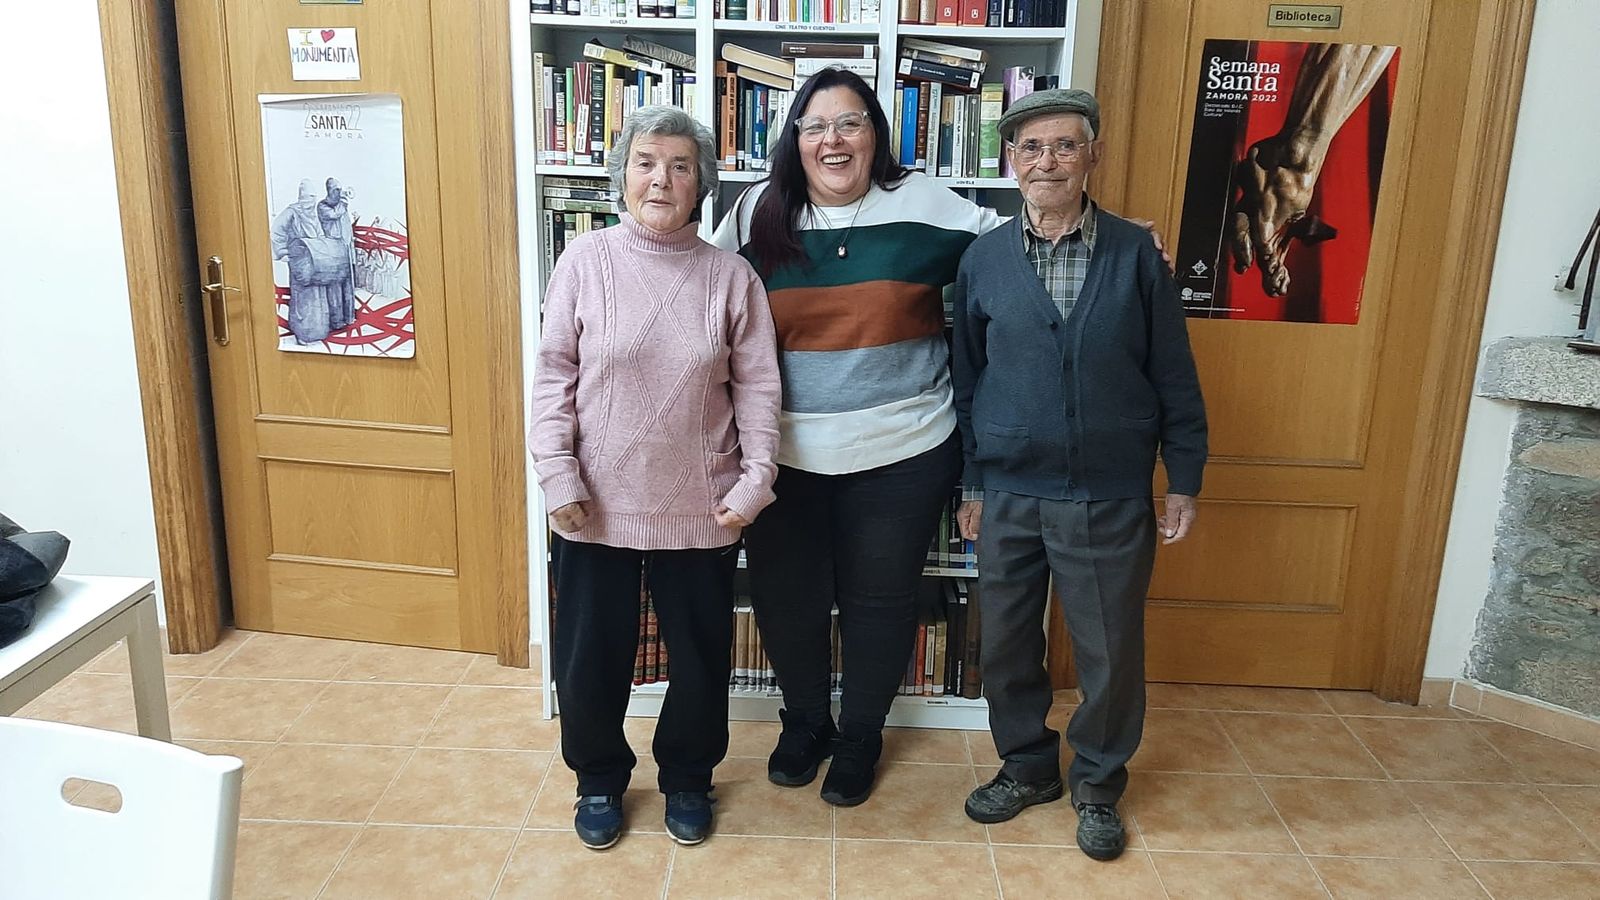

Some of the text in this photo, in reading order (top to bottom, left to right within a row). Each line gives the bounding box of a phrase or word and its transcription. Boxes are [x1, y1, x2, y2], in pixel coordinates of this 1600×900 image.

[1275, 10, 1332, 22] Biblioteca
[299, 30, 313, 46] I
[292, 47, 356, 63] MONUMENTA
[1209, 56, 1280, 74] Semana
[1206, 68, 1278, 92] Santa
[1205, 91, 1277, 102] ZAMORA 2022
[310, 114, 347, 130] SANTA
[304, 131, 363, 140] ZAMORA
